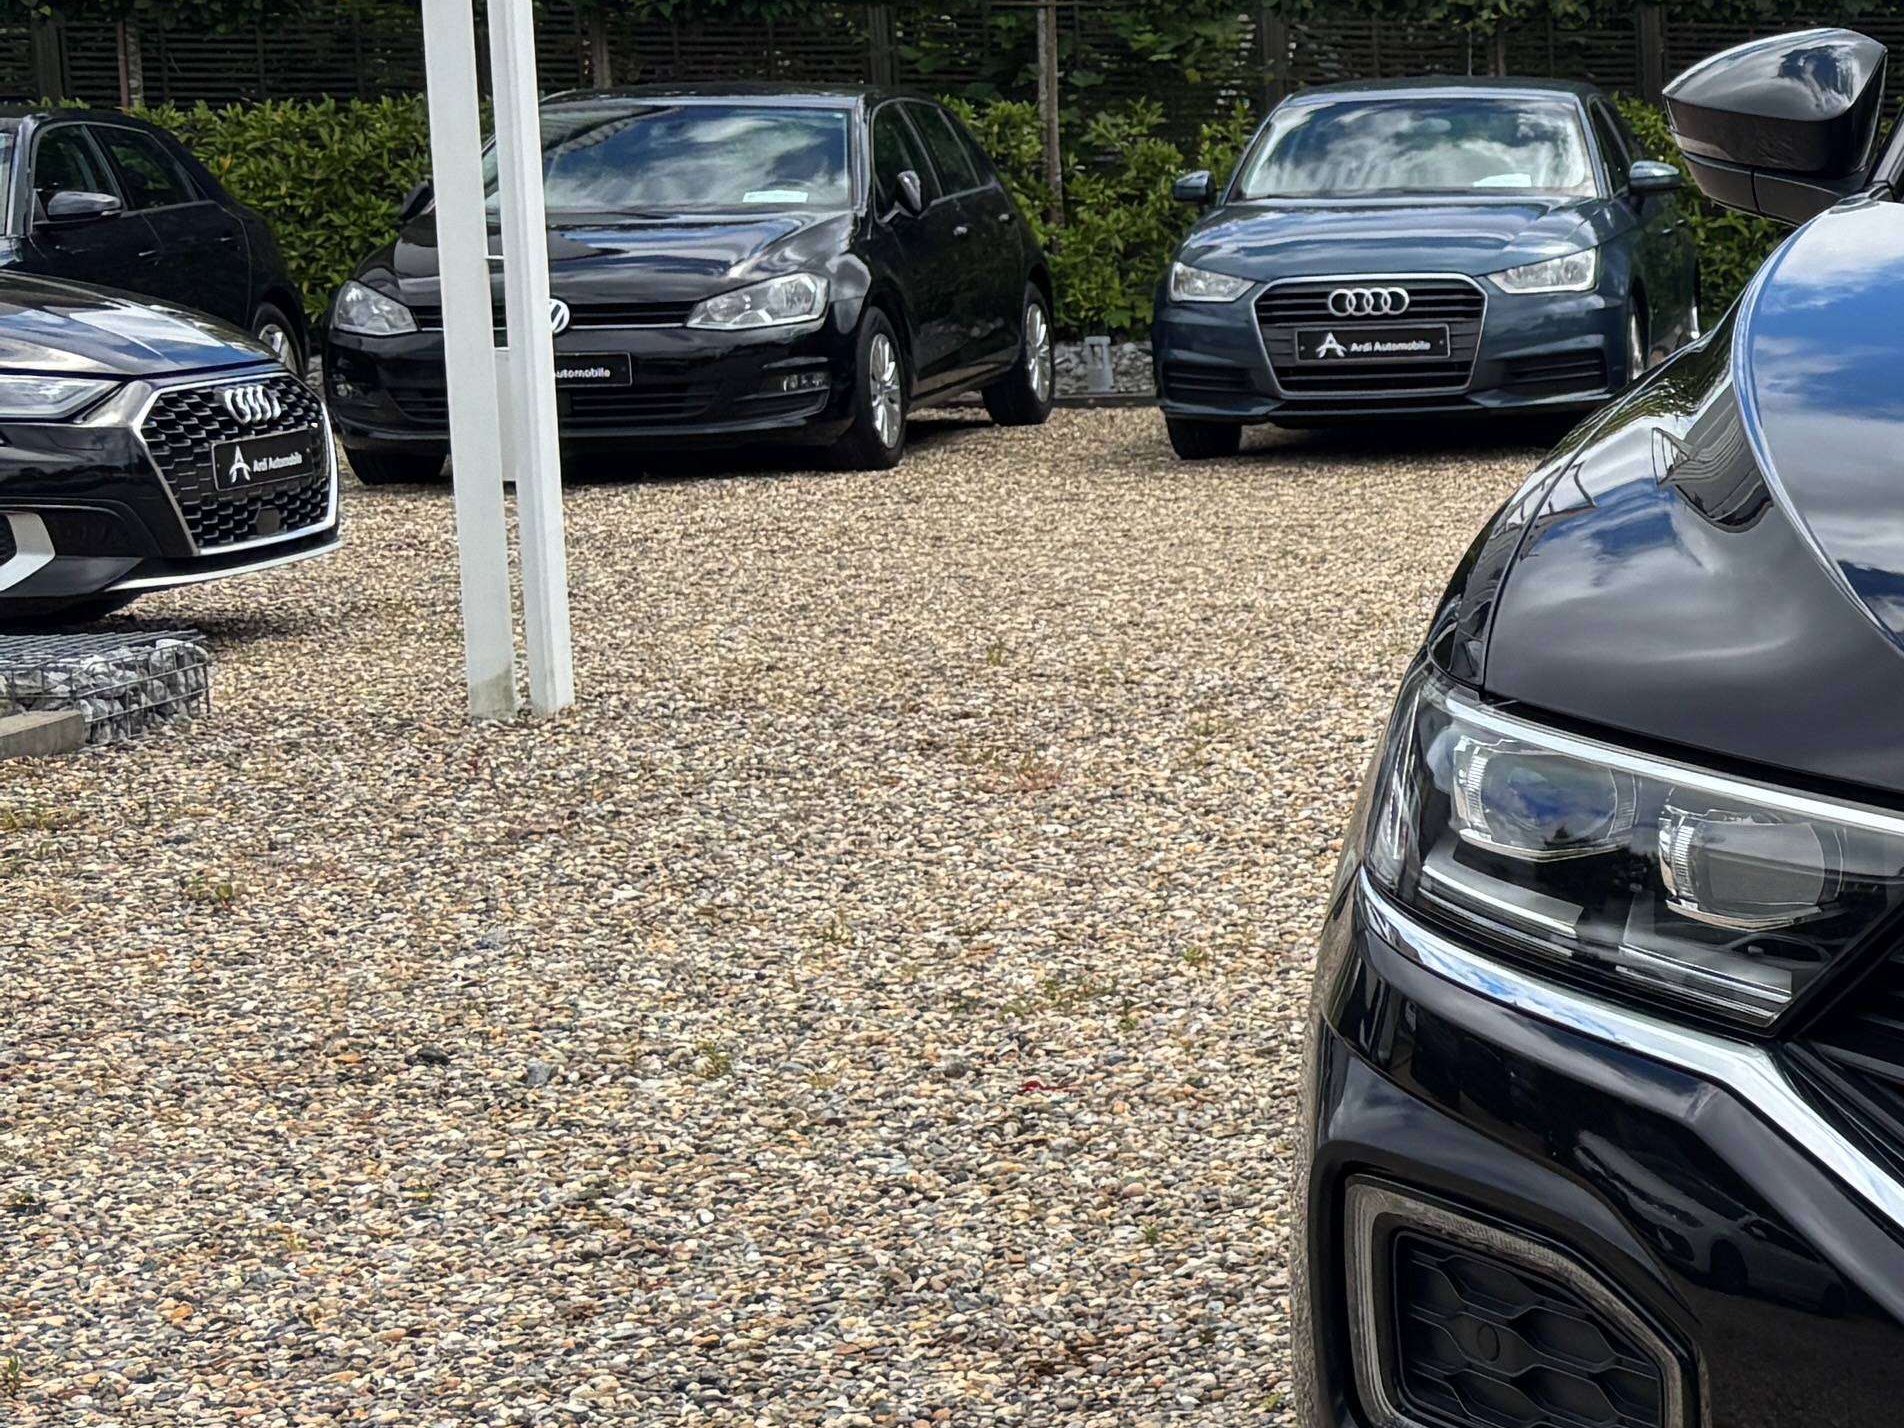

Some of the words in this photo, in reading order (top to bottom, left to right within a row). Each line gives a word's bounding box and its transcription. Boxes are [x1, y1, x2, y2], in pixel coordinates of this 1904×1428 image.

[1350, 341, 1373, 353] Ardi
[1373, 340, 1431, 352] Automobile
[554, 366, 611, 379] utomobile
